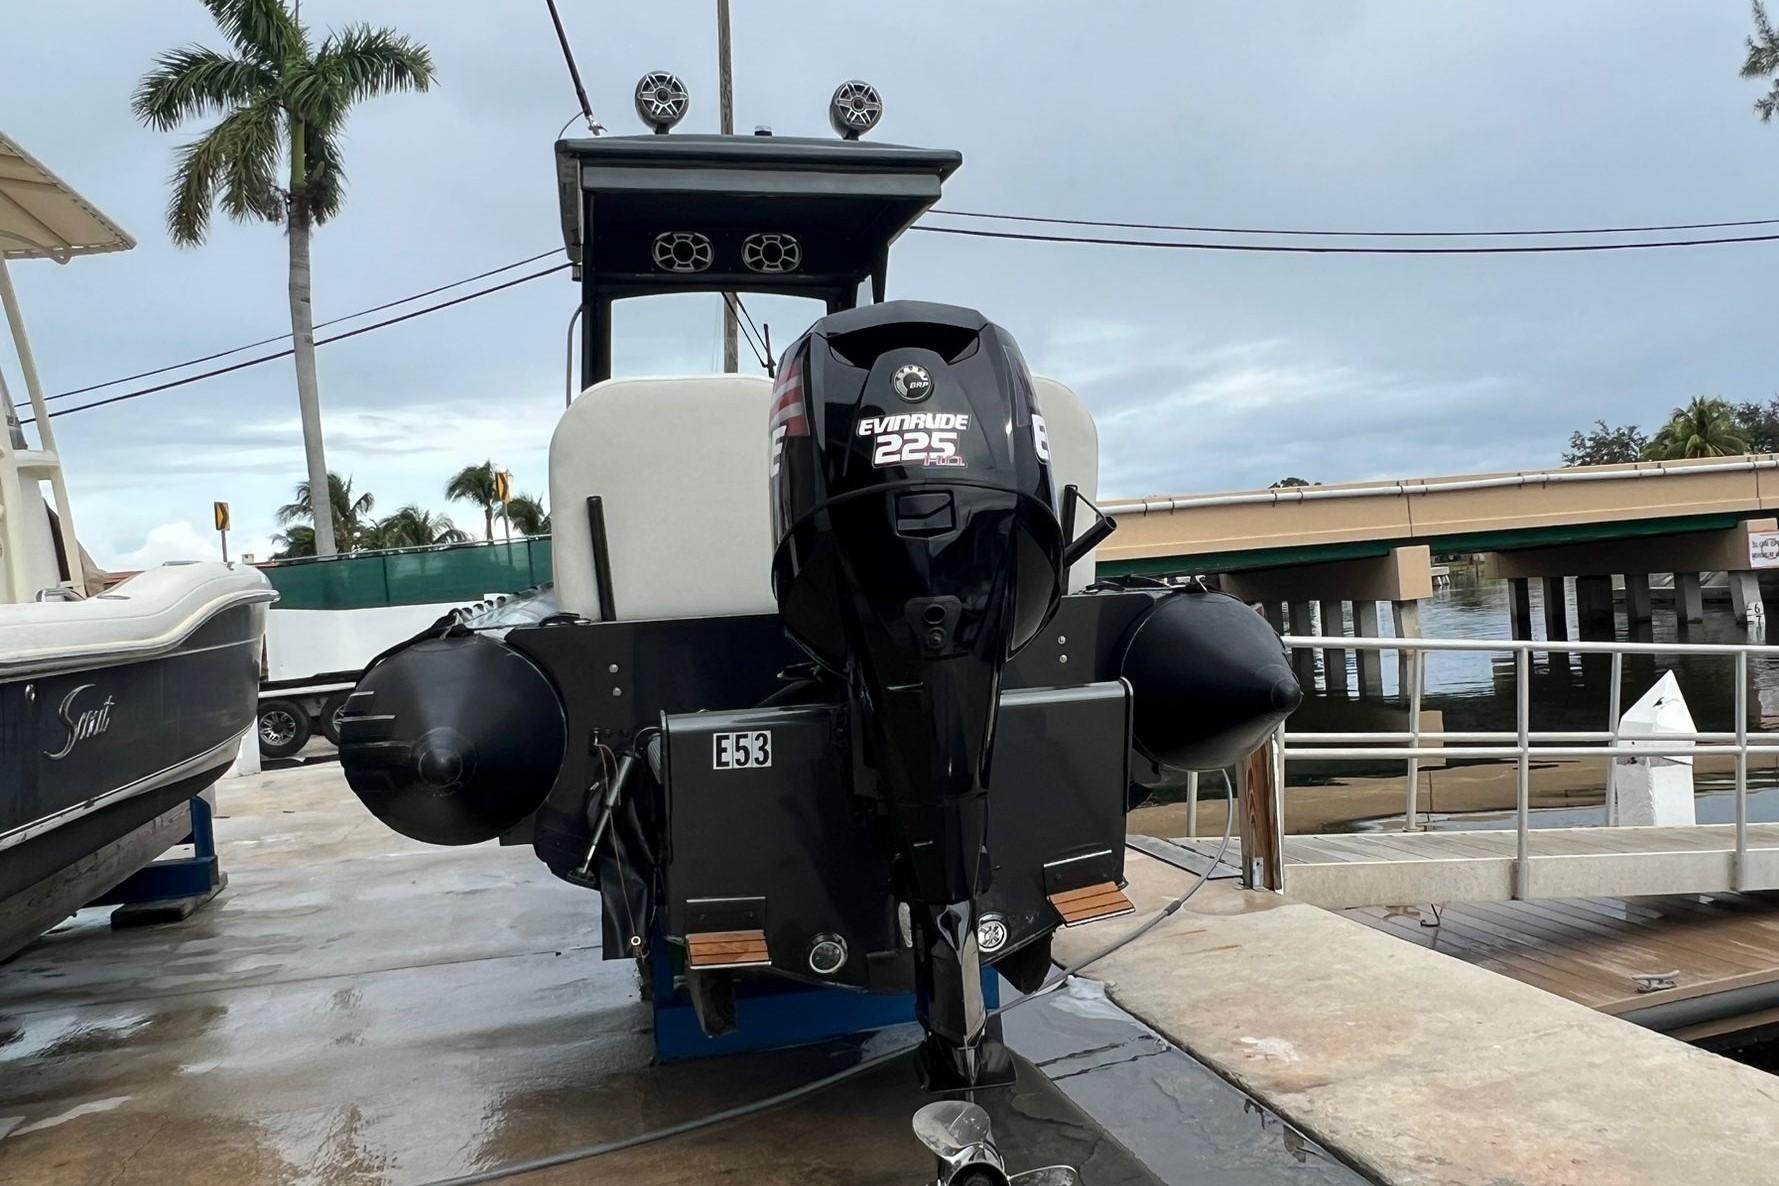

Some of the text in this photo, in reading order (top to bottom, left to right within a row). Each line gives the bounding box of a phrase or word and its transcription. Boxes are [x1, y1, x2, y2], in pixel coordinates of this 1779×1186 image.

[858, 412, 969, 436] EVINRUDE
[874, 431, 958, 465] 225
[1754, 602, 1761, 614] 6
[715, 732, 770, 768] E53
